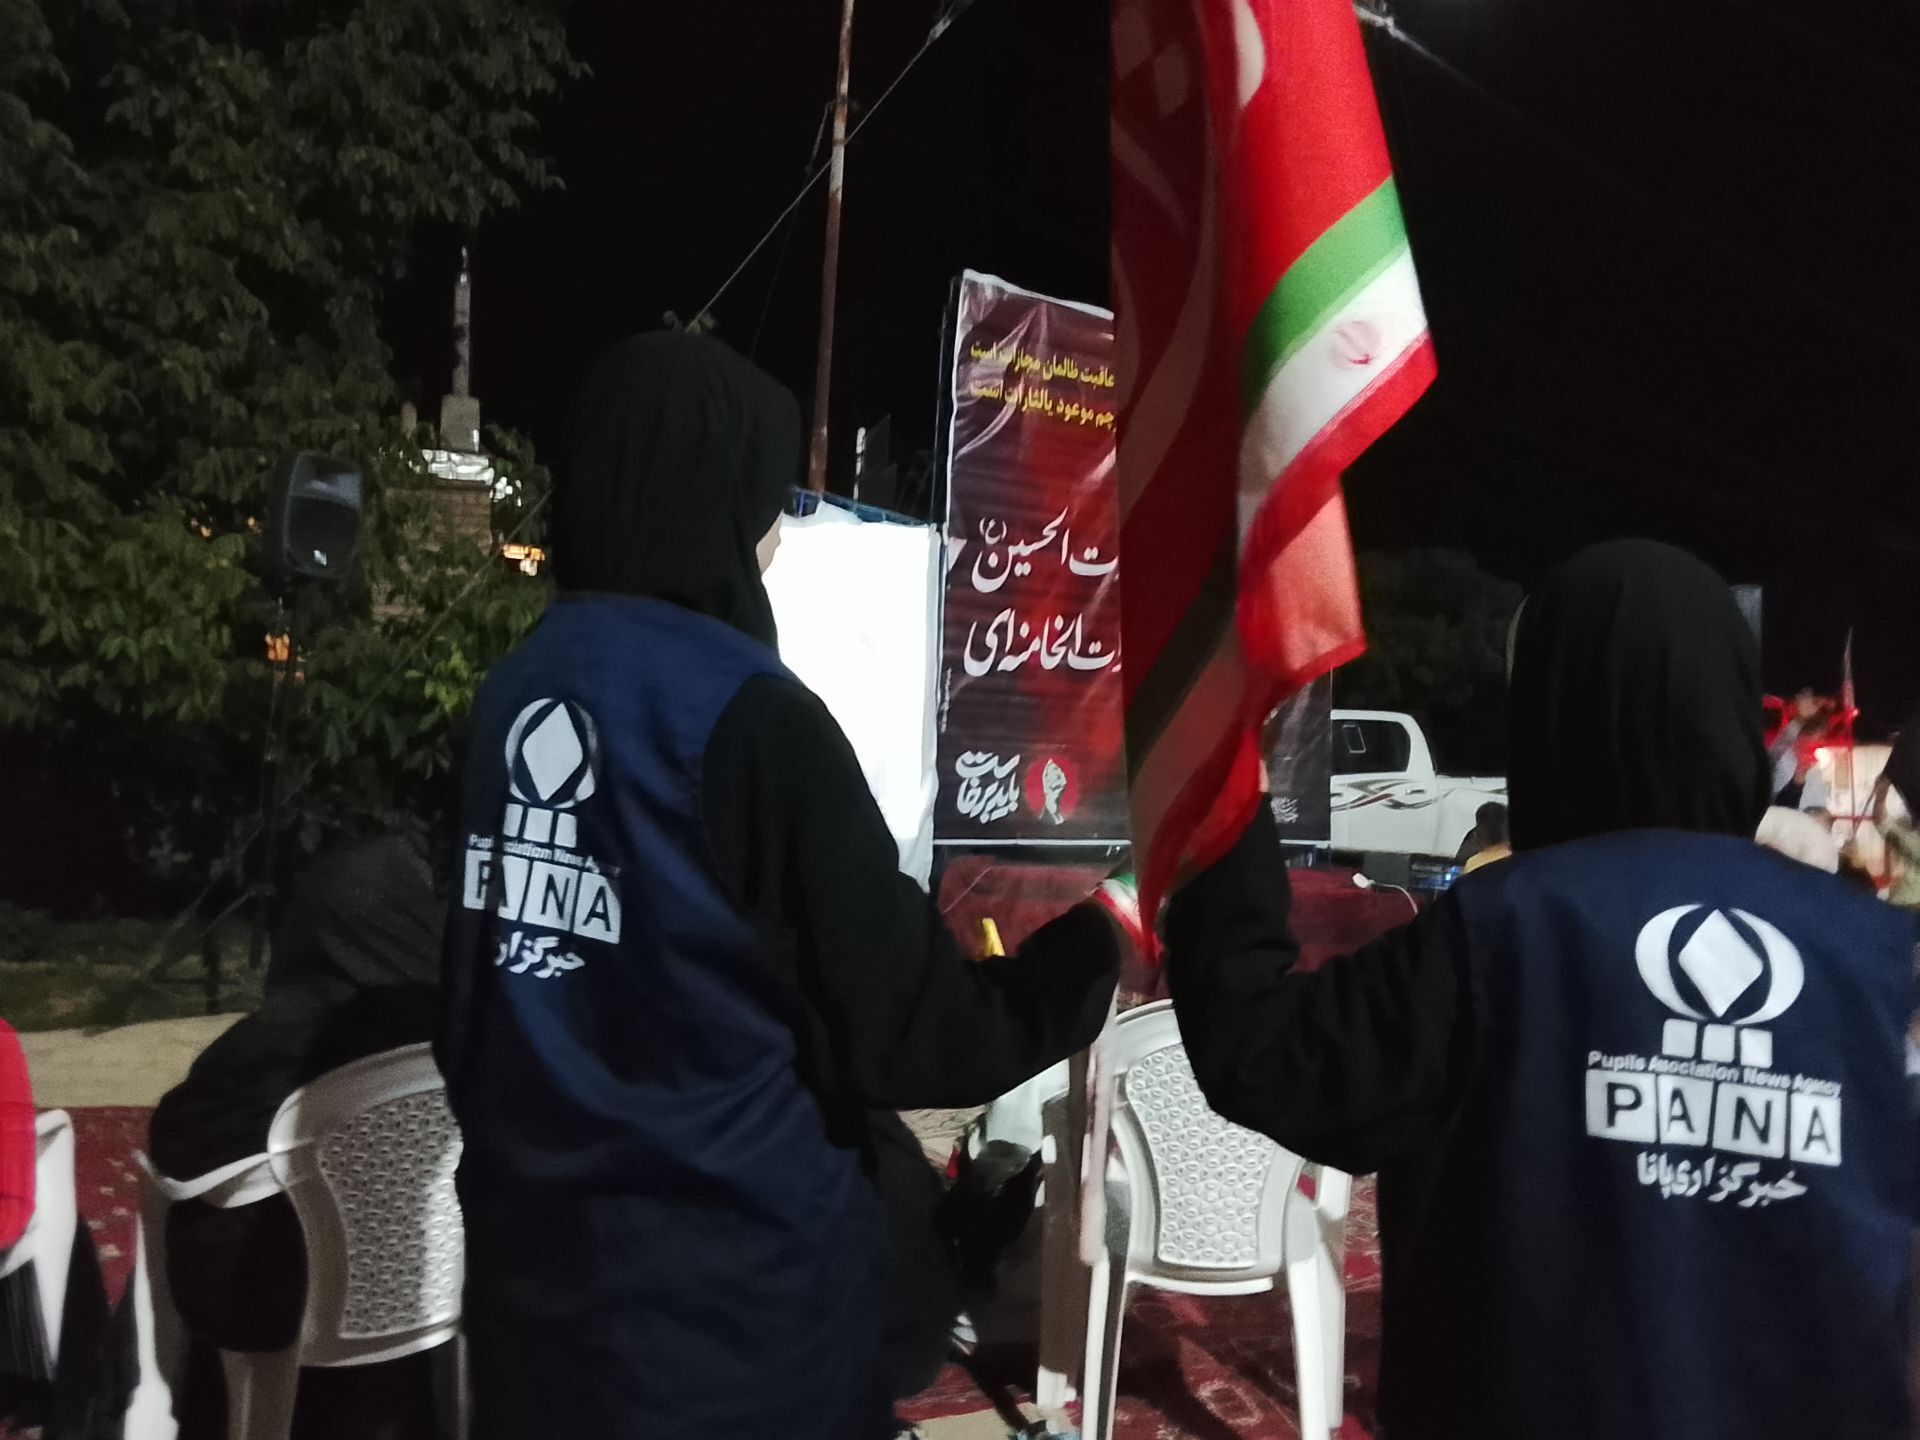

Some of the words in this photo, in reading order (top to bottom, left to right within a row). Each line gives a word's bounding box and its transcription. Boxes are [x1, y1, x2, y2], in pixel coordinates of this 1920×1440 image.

[1043, 353, 1079, 380] ظالمان
[1081, 366, 1115, 389] عاقبت
[1056, 398, 1094, 425] موعود
[971, 506, 1070, 593] الحسین
[1588, 1050, 1646, 1072] Pupils
[1743, 1067, 1791, 1089] News
[1792, 1073, 1842, 1098] Agency
[1599, 1076, 1836, 1160] PANA
